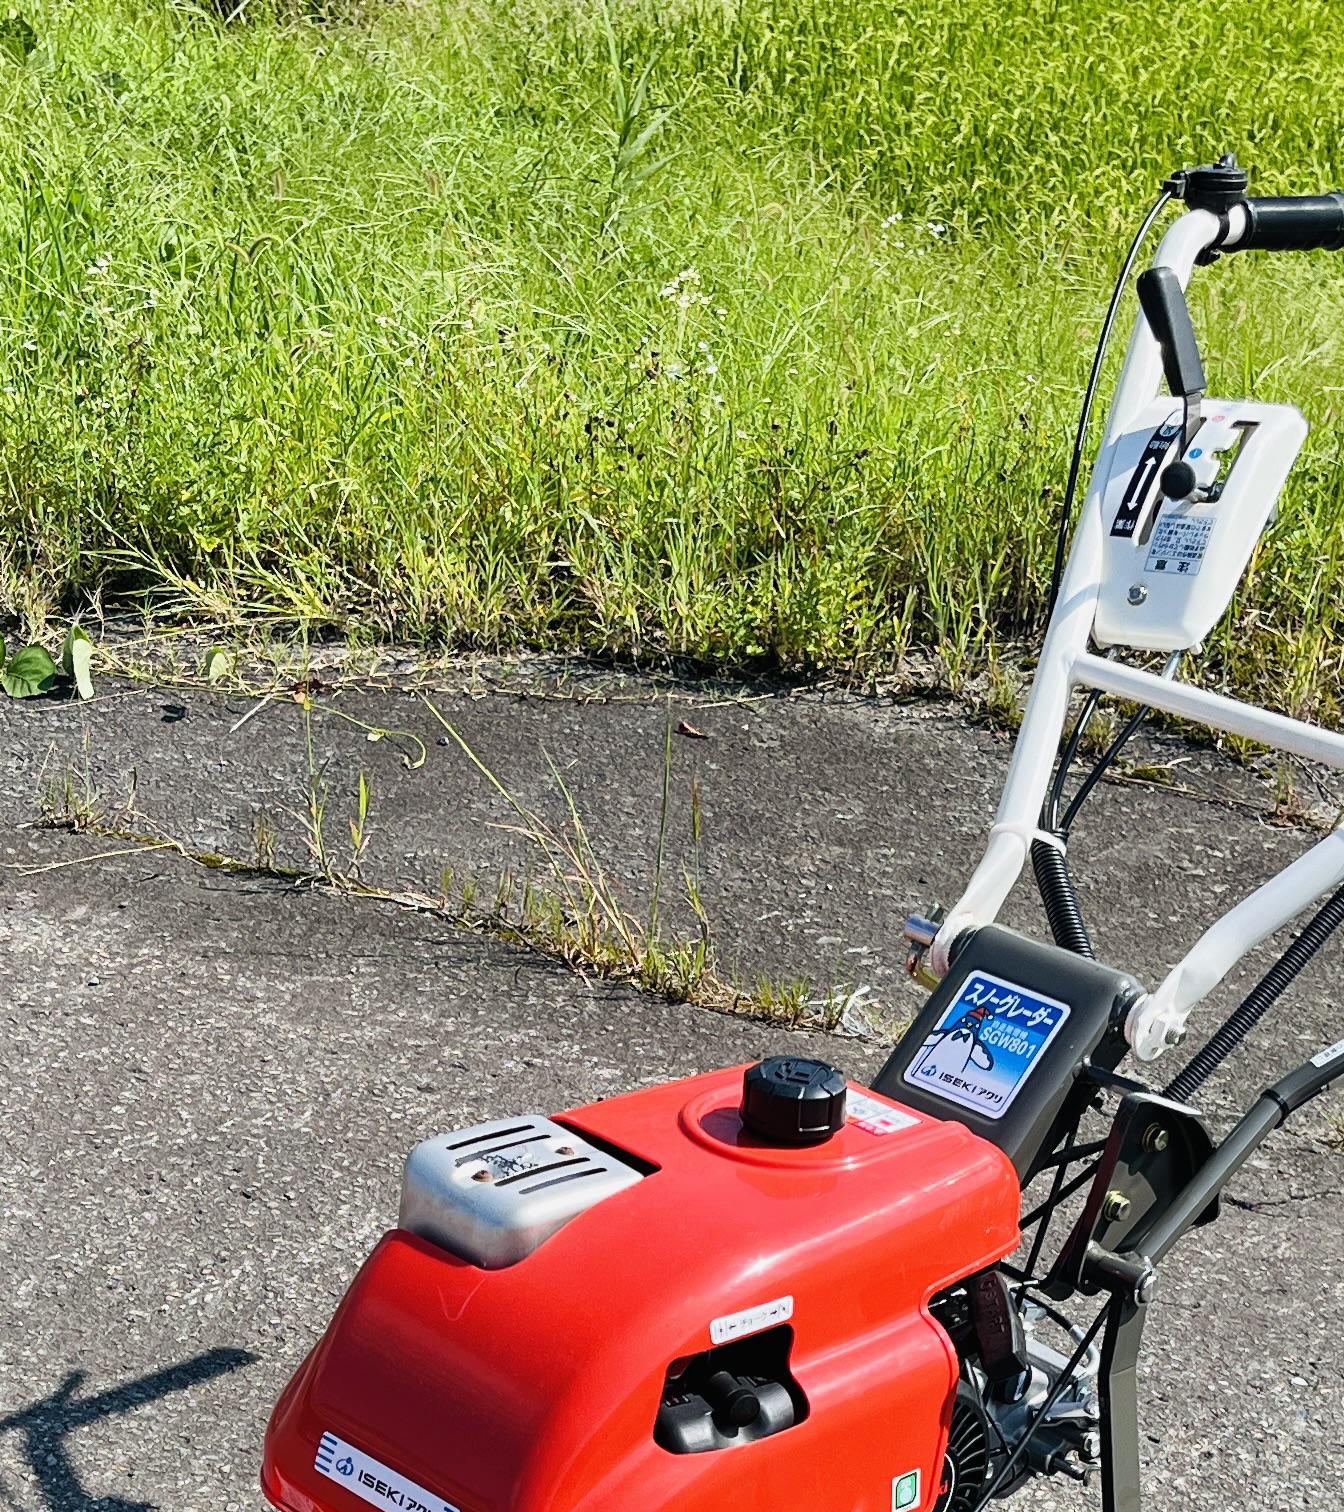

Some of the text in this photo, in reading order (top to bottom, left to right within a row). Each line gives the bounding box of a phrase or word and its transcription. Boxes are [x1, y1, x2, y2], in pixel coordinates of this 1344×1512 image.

[1113, 520, 1136, 531] 作業
[964, 983, 1055, 1028] スノーグレーダー
[979, 1026, 1037, 1059] SGW801
